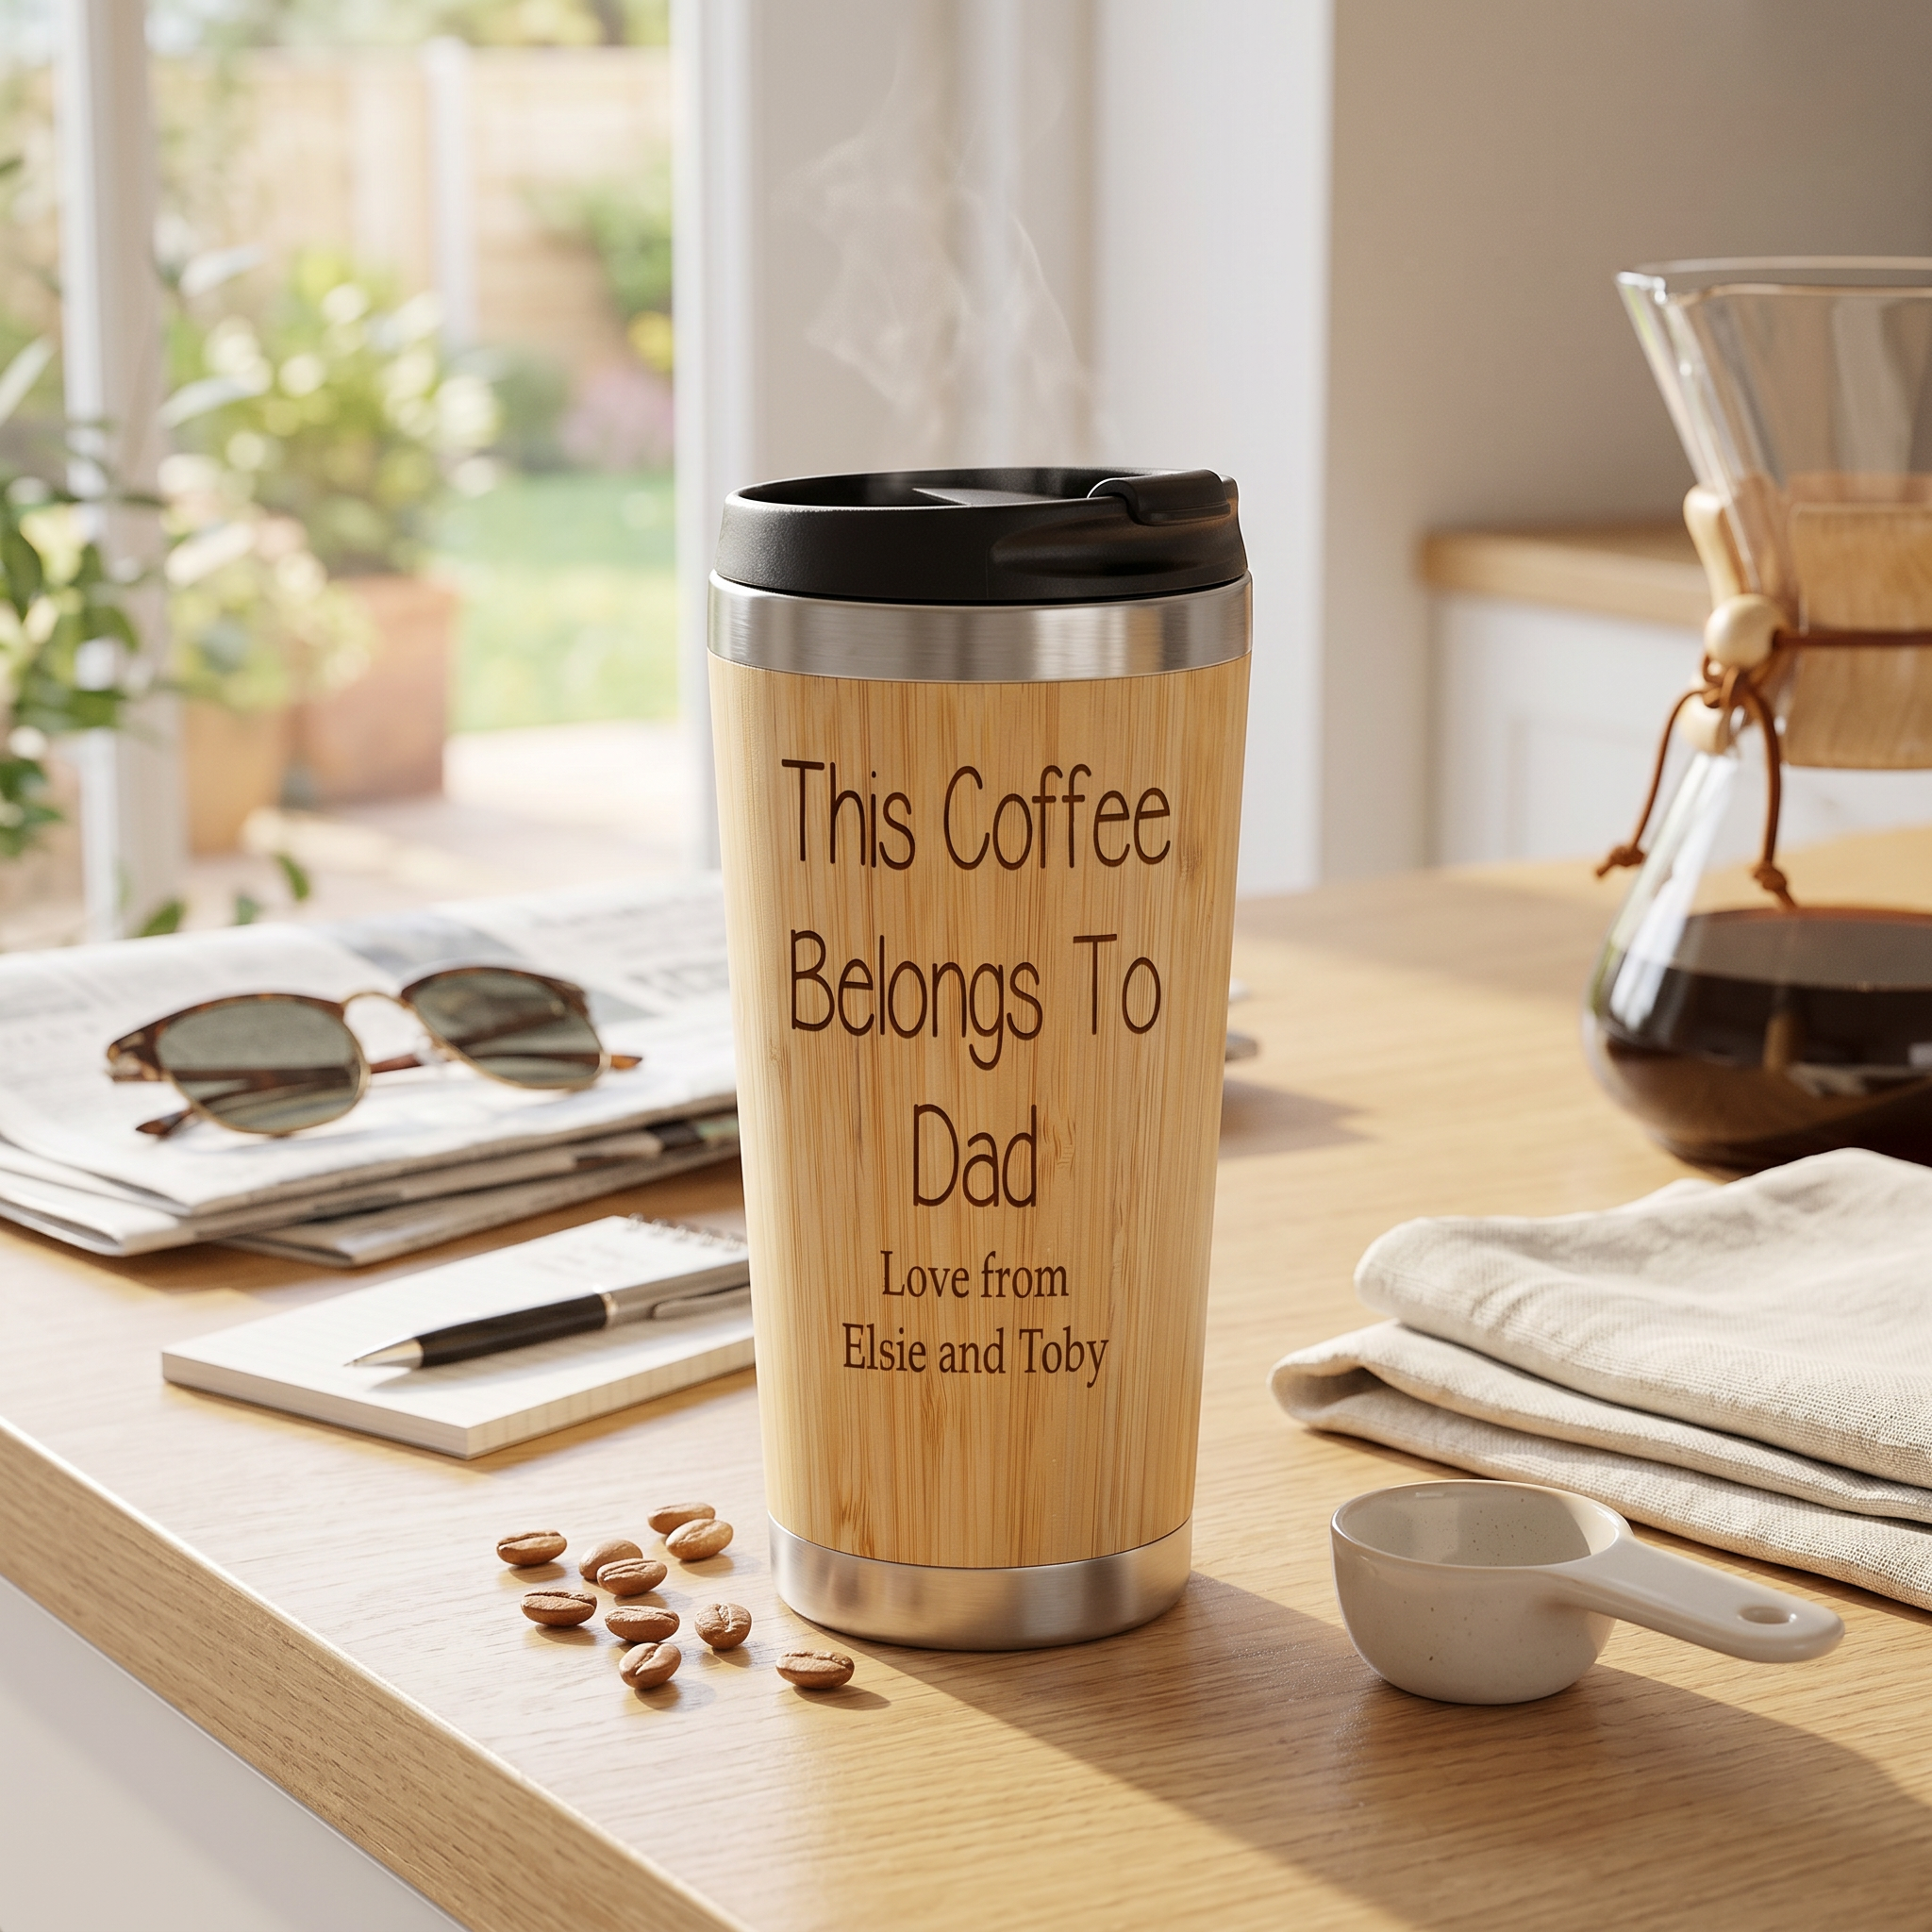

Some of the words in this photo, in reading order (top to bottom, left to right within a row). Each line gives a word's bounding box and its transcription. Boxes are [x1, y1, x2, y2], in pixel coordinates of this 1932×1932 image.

[782, 758, 916, 871] This
[943, 763, 1172, 872] Coffee
[791, 928, 1043, 1072] Belongs
[1073, 933, 1162, 1036] To
[912, 1103, 1038, 1208] Dad
[879, 1250, 971, 1298] Love
[981, 1250, 1070, 1299] from
[841, 1322, 926, 1374] Elsie
[939, 1326, 1007, 1374] and
[1018, 1324, 1109, 1390] Toby
